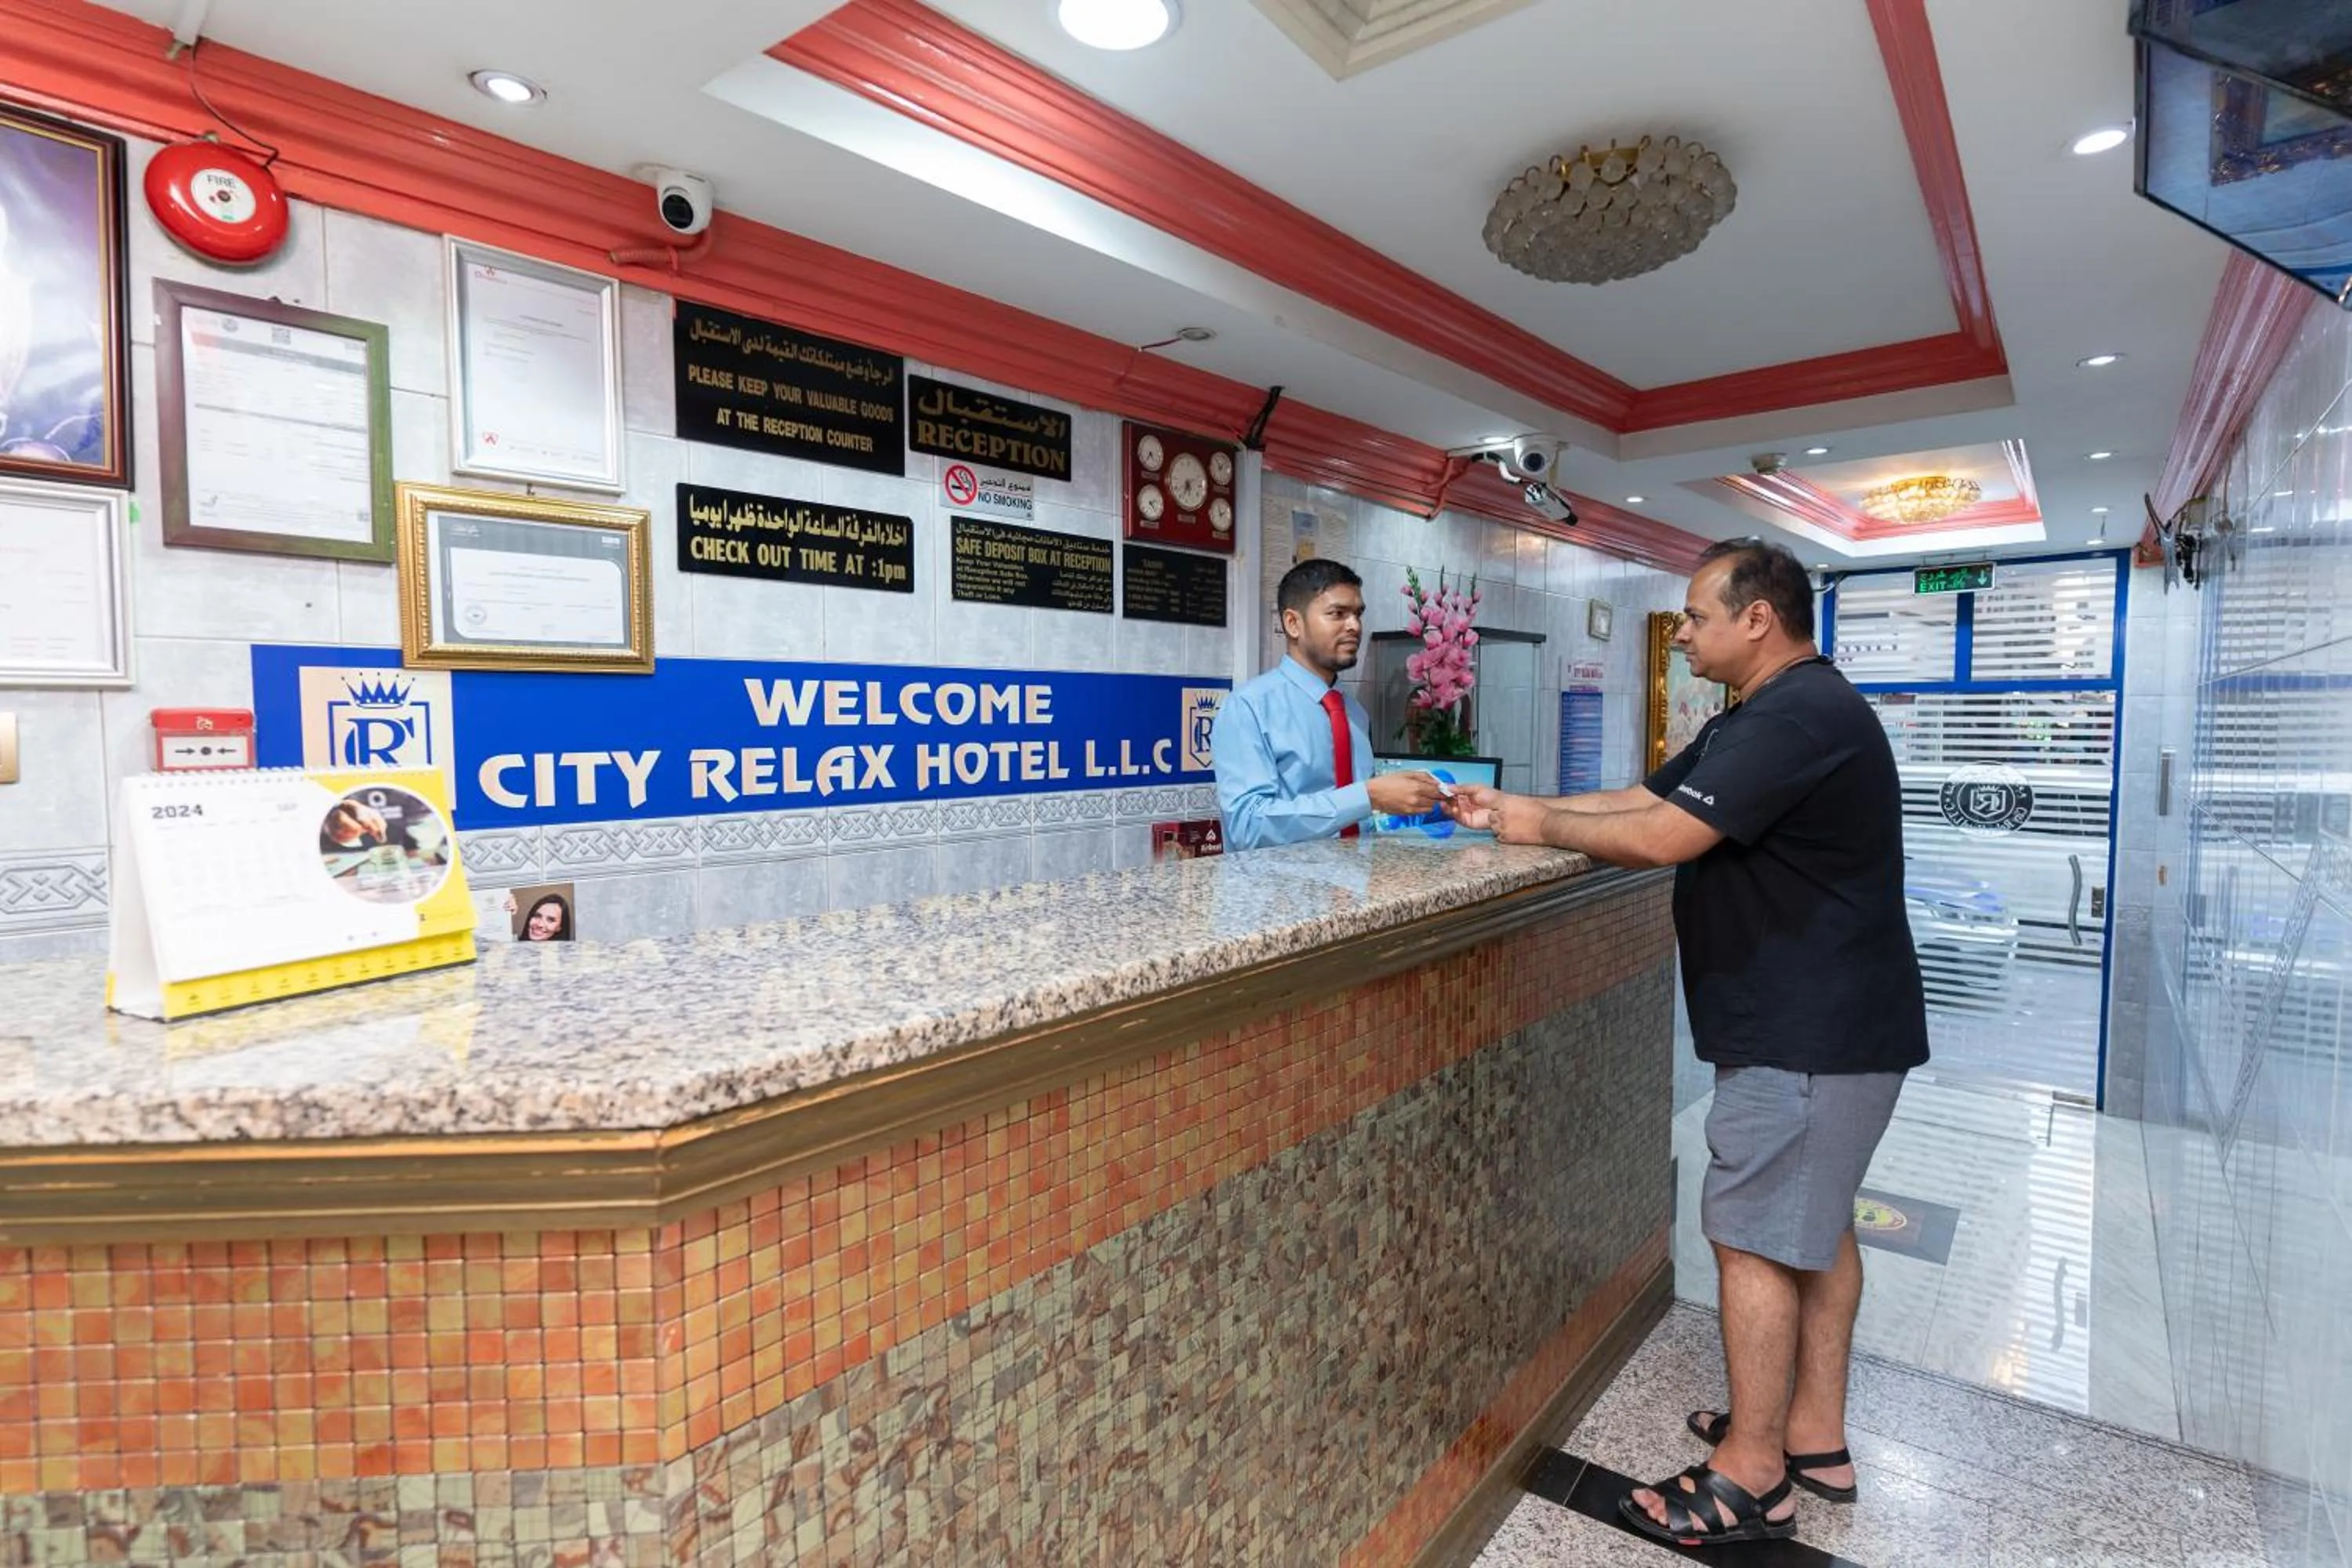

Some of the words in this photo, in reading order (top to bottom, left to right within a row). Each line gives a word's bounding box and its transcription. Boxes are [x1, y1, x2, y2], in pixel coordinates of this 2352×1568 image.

[207, 175, 235, 188] FIRE
[690, 318, 741, 345] الاستقبال
[688, 364, 733, 389] PLEASE
[739, 376, 768, 398] KEEP
[773, 383, 802, 404] YOUR
[807, 389, 857, 415] VALUABLE
[861, 402, 894, 423] GOODS
[717, 408, 731, 426] AT
[736, 412, 759, 430] THE
[764, 417, 822, 444] RECEPTION
[827, 430, 873, 452] COUNTER
[918, 388, 1065, 440] الاستقبال
[917, 419, 1065, 472] RECEPTION
[689, 493, 722, 528] يوميا
[978, 492, 991, 503] NO
[993, 494, 1033, 510] SMOKING
[757, 503, 804, 538] الواحدة
[804, 510, 844, 538] الساعة
[690, 536, 750, 564] CHECK
[757, 543, 791, 568] OUT
[800, 548, 837, 573] TIME
[844, 553, 864, 575] AT
[956, 536, 982, 556] SAFE
[985, 539, 1025, 562] DEPOSIT
[1028, 547, 1047, 564] BOX
[1050, 551, 1062, 566] AT
[1064, 552, 1111, 572] RECEPTION
[1919, 580, 1947, 592] EXIT
[743, 678, 1054, 726] WELCOME
[478, 750, 662, 809] CITY
[688, 746, 896, 803] RELAX
[916, 740, 1069, 791] HOTEL
[1084, 739, 1173, 778] L.L.C
[151, 804, 204, 820] 2024
